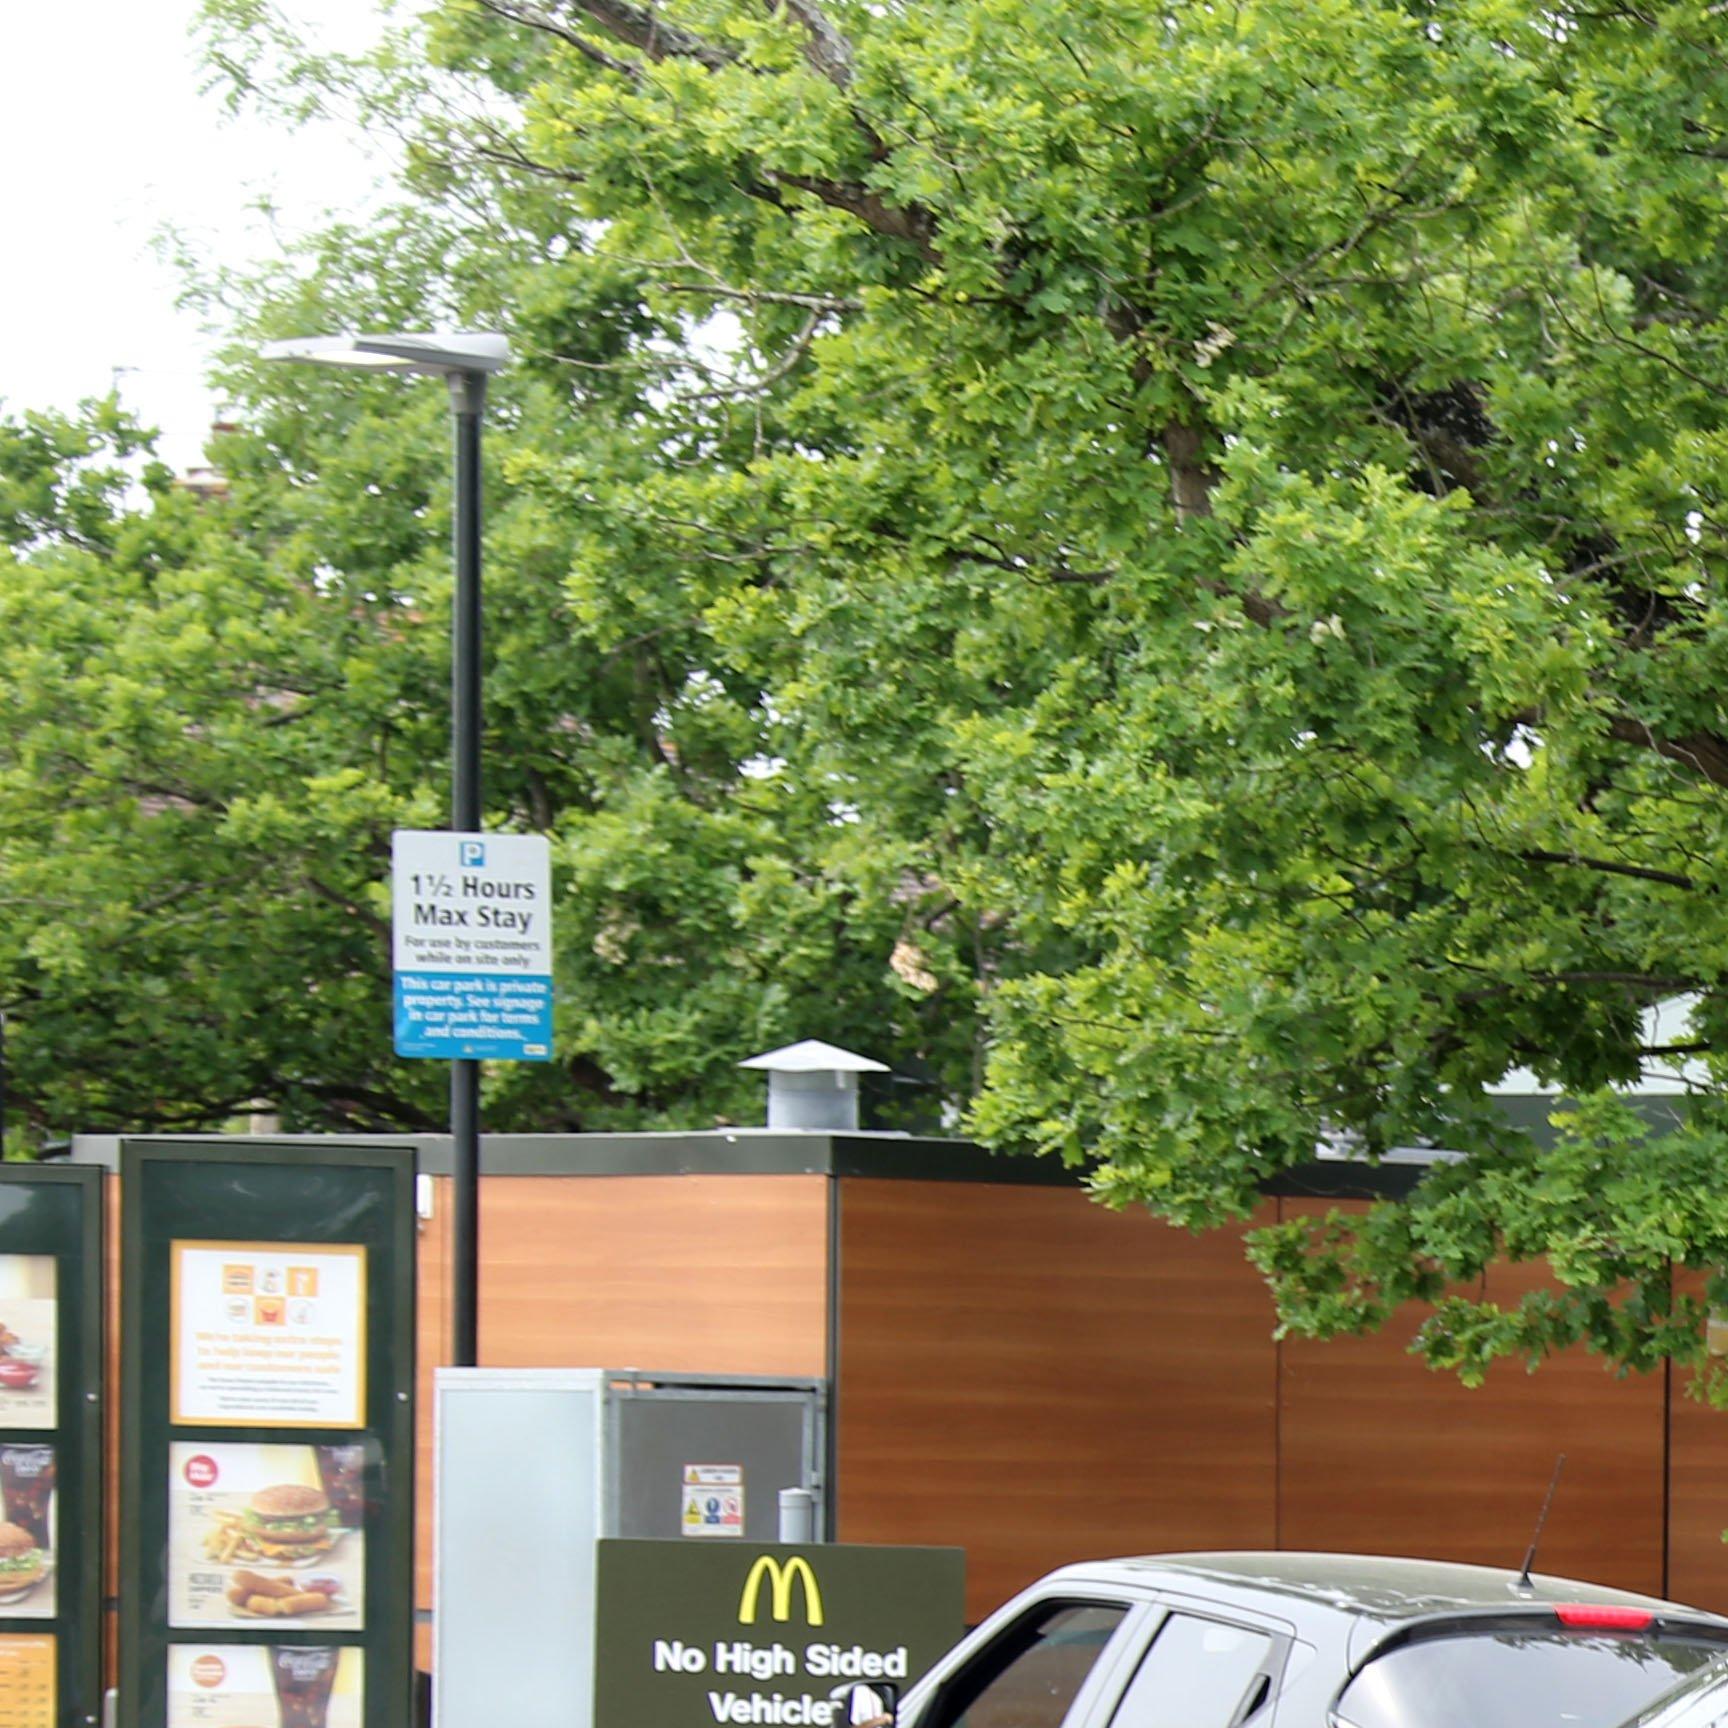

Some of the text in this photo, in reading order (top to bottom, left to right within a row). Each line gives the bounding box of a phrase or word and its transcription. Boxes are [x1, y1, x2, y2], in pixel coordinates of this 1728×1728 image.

[462, 875, 535, 900] Hours
[413, 904, 533, 934] Max Stay
[405, 936, 541, 952] For use by customers
[416, 951, 531, 969] while on site only
[653, 1639, 908, 1680] No High Sided
[708, 1690, 842, 1726] Vehicle
